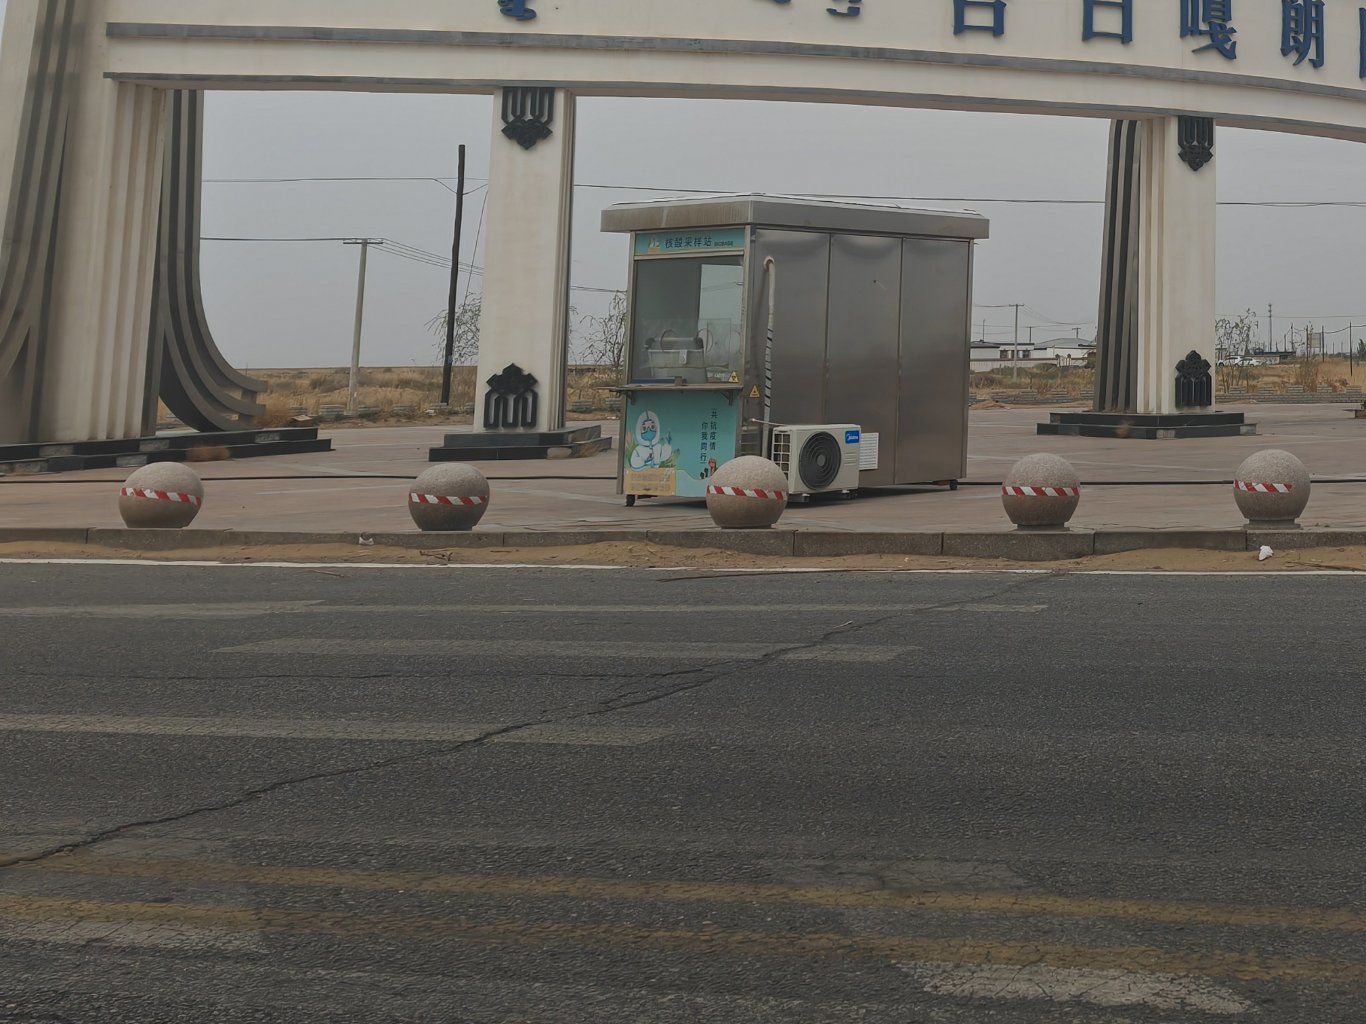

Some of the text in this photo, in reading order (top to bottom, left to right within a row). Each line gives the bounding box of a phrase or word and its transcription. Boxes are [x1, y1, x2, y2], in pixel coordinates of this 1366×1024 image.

[664, 236, 713, 249] 核酸采样站
